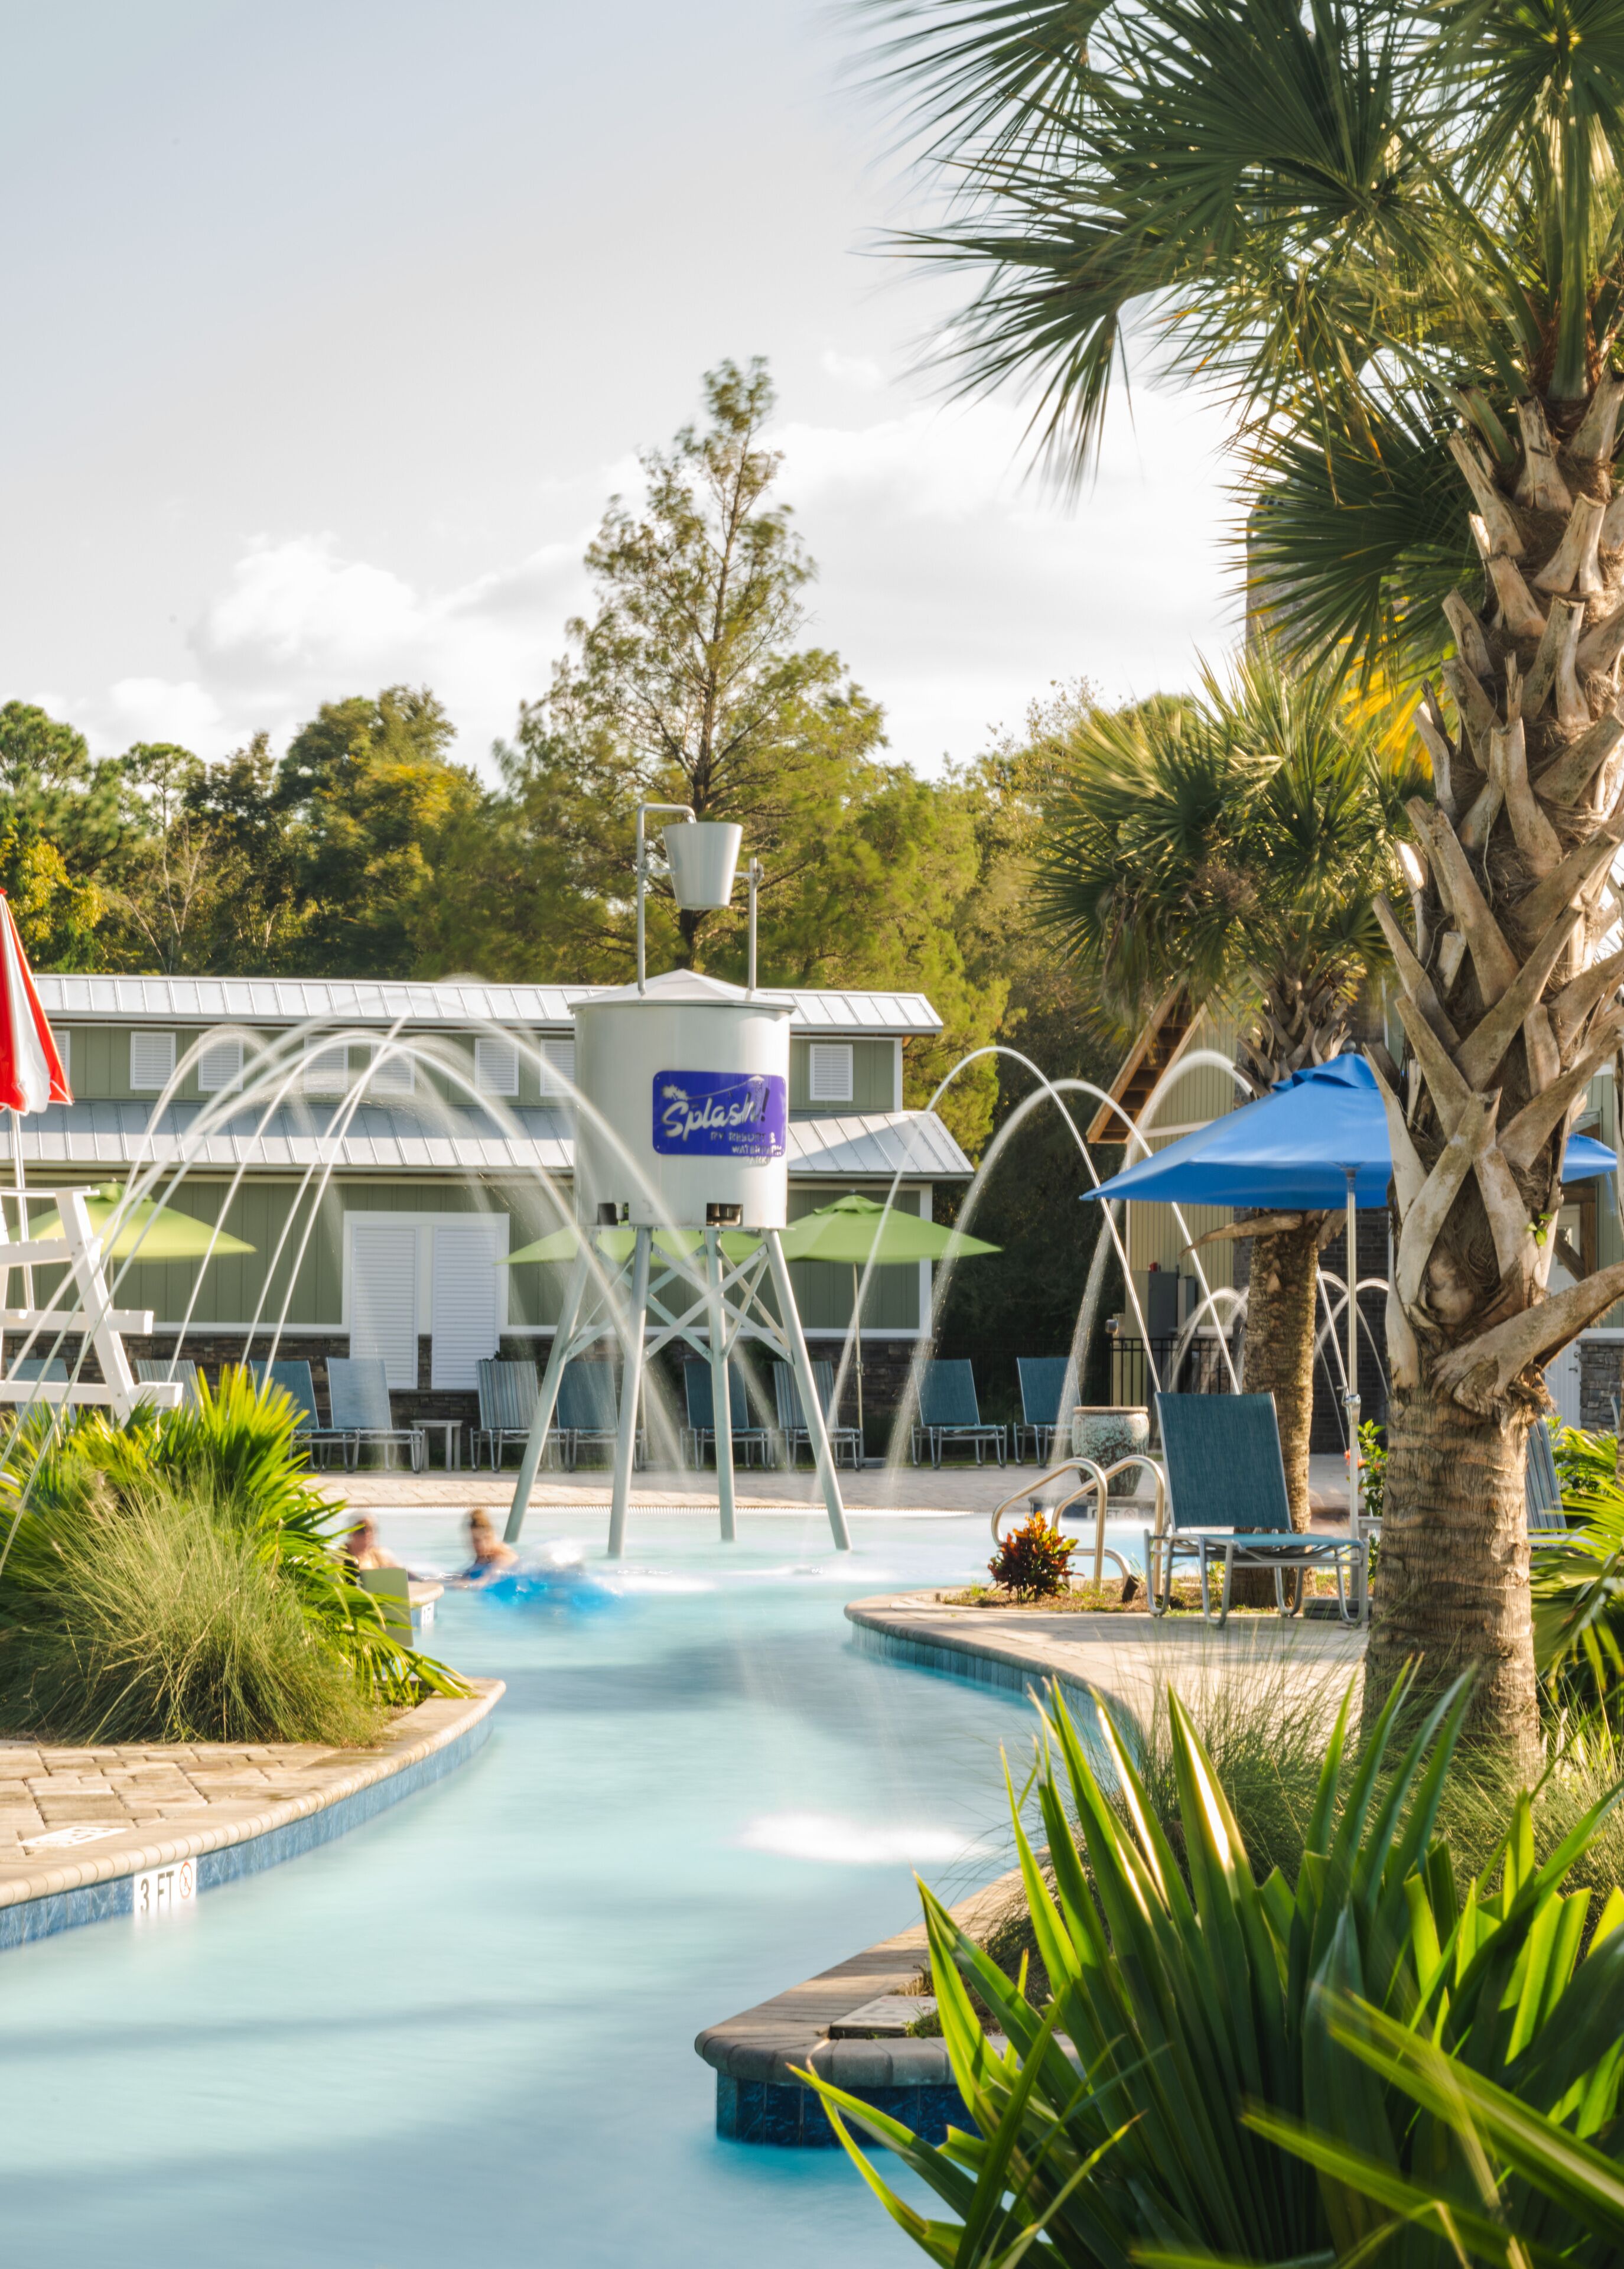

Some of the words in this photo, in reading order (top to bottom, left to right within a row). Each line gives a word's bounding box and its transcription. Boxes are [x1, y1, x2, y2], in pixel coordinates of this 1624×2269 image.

[661, 1087, 770, 1142] Splash!
[711, 1132, 724, 1142] RV
[729, 1132, 766, 1143] RESORT
[770, 1132, 776, 1144] &
[140, 1878, 150, 1911] 3
[157, 1871, 175, 1907] FT
